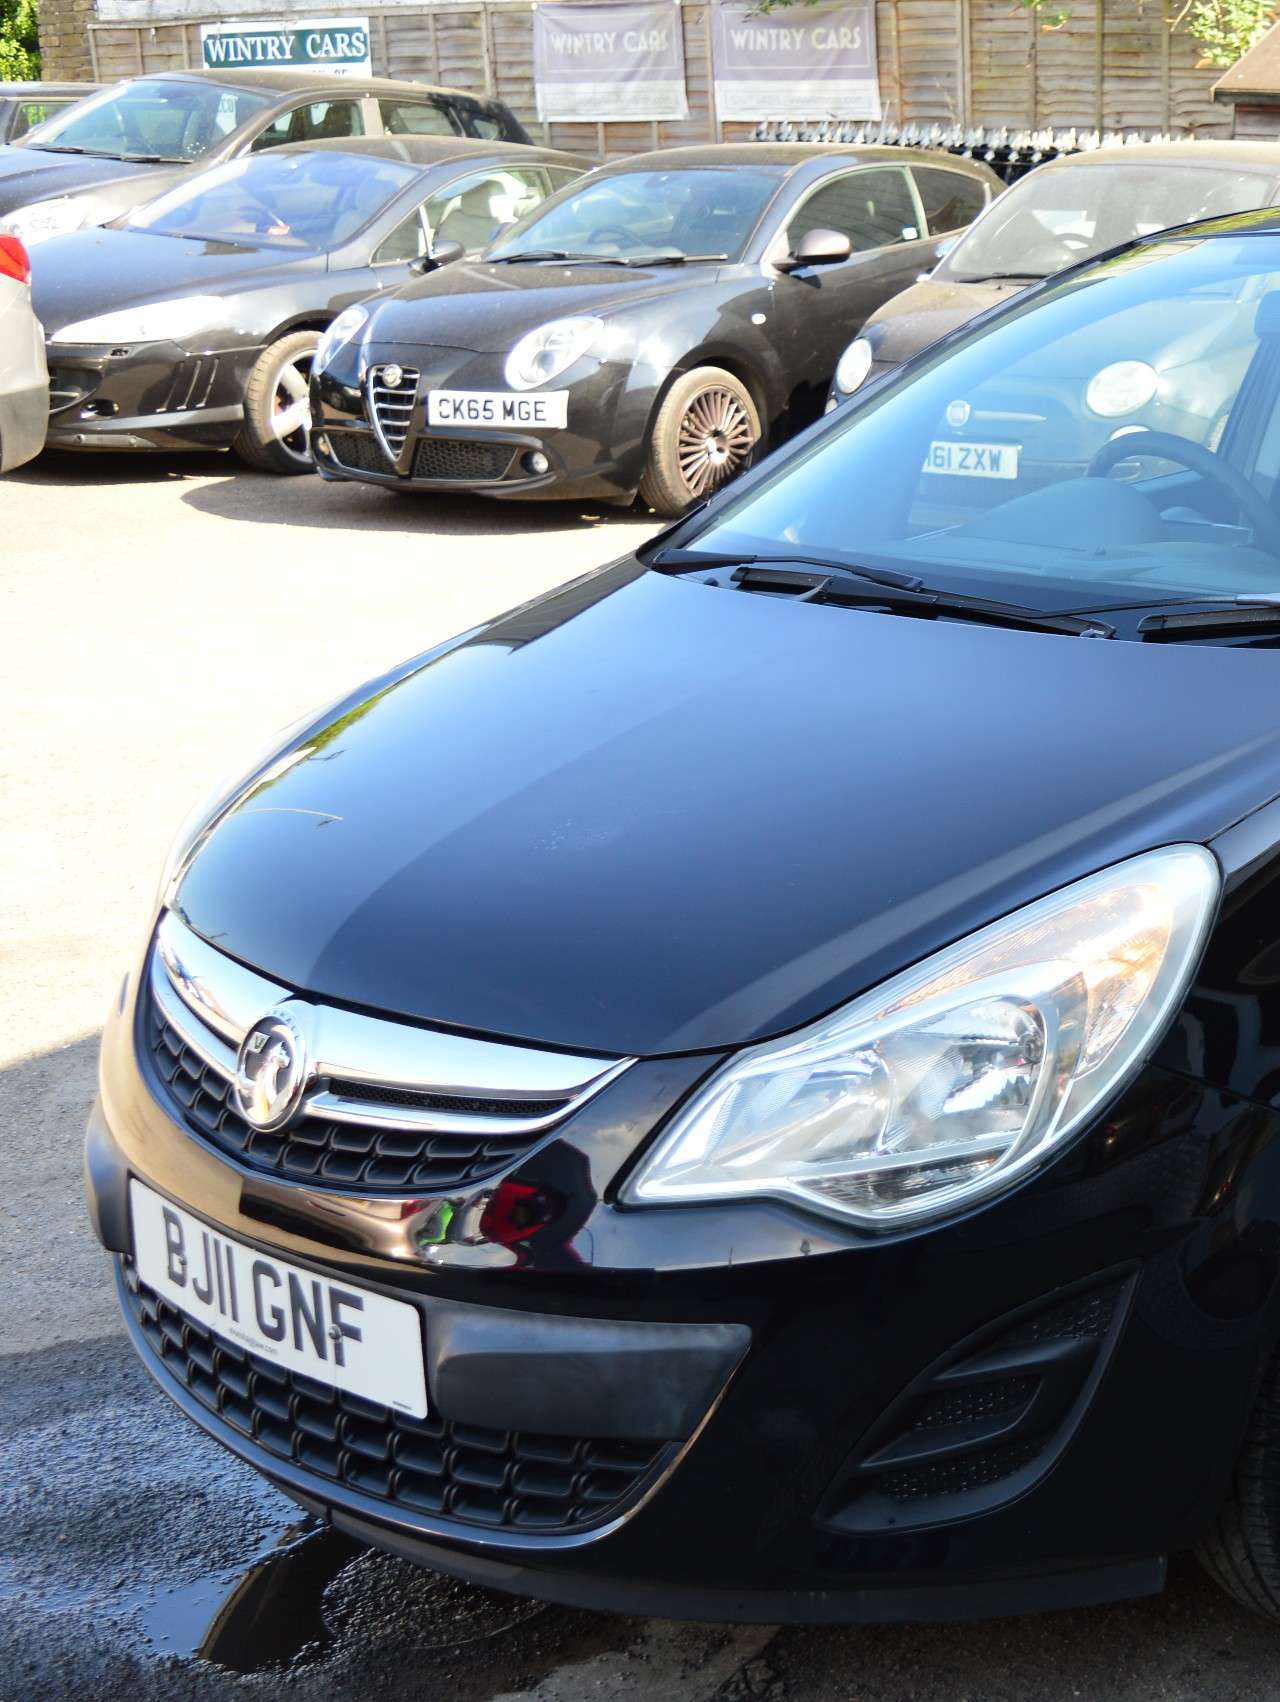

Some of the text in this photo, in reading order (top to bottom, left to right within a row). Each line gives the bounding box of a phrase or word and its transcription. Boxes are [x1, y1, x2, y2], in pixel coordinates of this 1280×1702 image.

[206, 32, 366, 62] WINTRY CARS
[550, 28, 668, 55] WINTRY CARS
[730, 26, 861, 50] WINTRY CARS
[438, 399, 546, 422] CK65 MGE
[959, 447, 1002, 473] ZXW
[162, 1206, 364, 1368] BJ11 GNF
